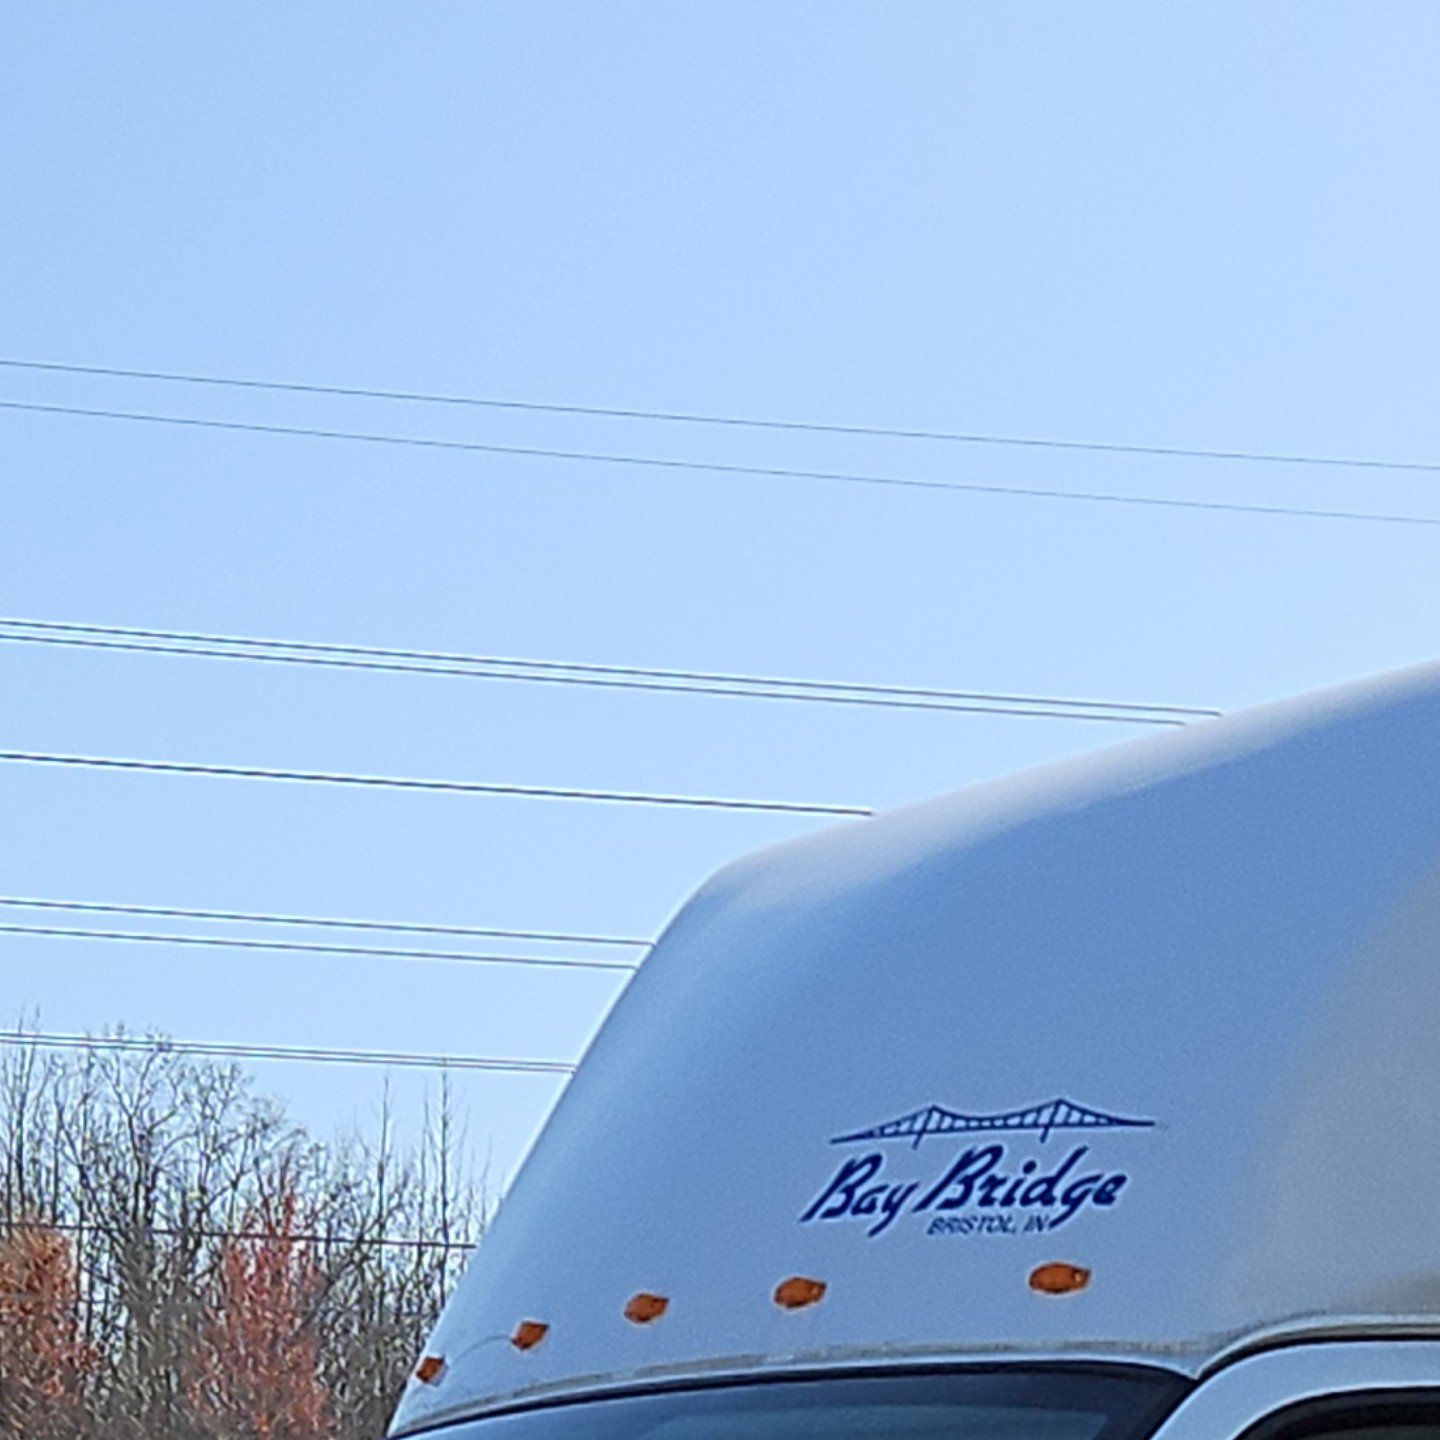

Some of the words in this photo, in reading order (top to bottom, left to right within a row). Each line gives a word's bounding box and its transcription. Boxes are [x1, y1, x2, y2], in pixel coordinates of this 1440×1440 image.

[799, 1152, 921, 1238] Bay
[911, 1144, 1129, 1231] Bridge
[926, 1214, 1016, 1236] BRISTOL,
[1022, 1213, 1051, 1233] IN
